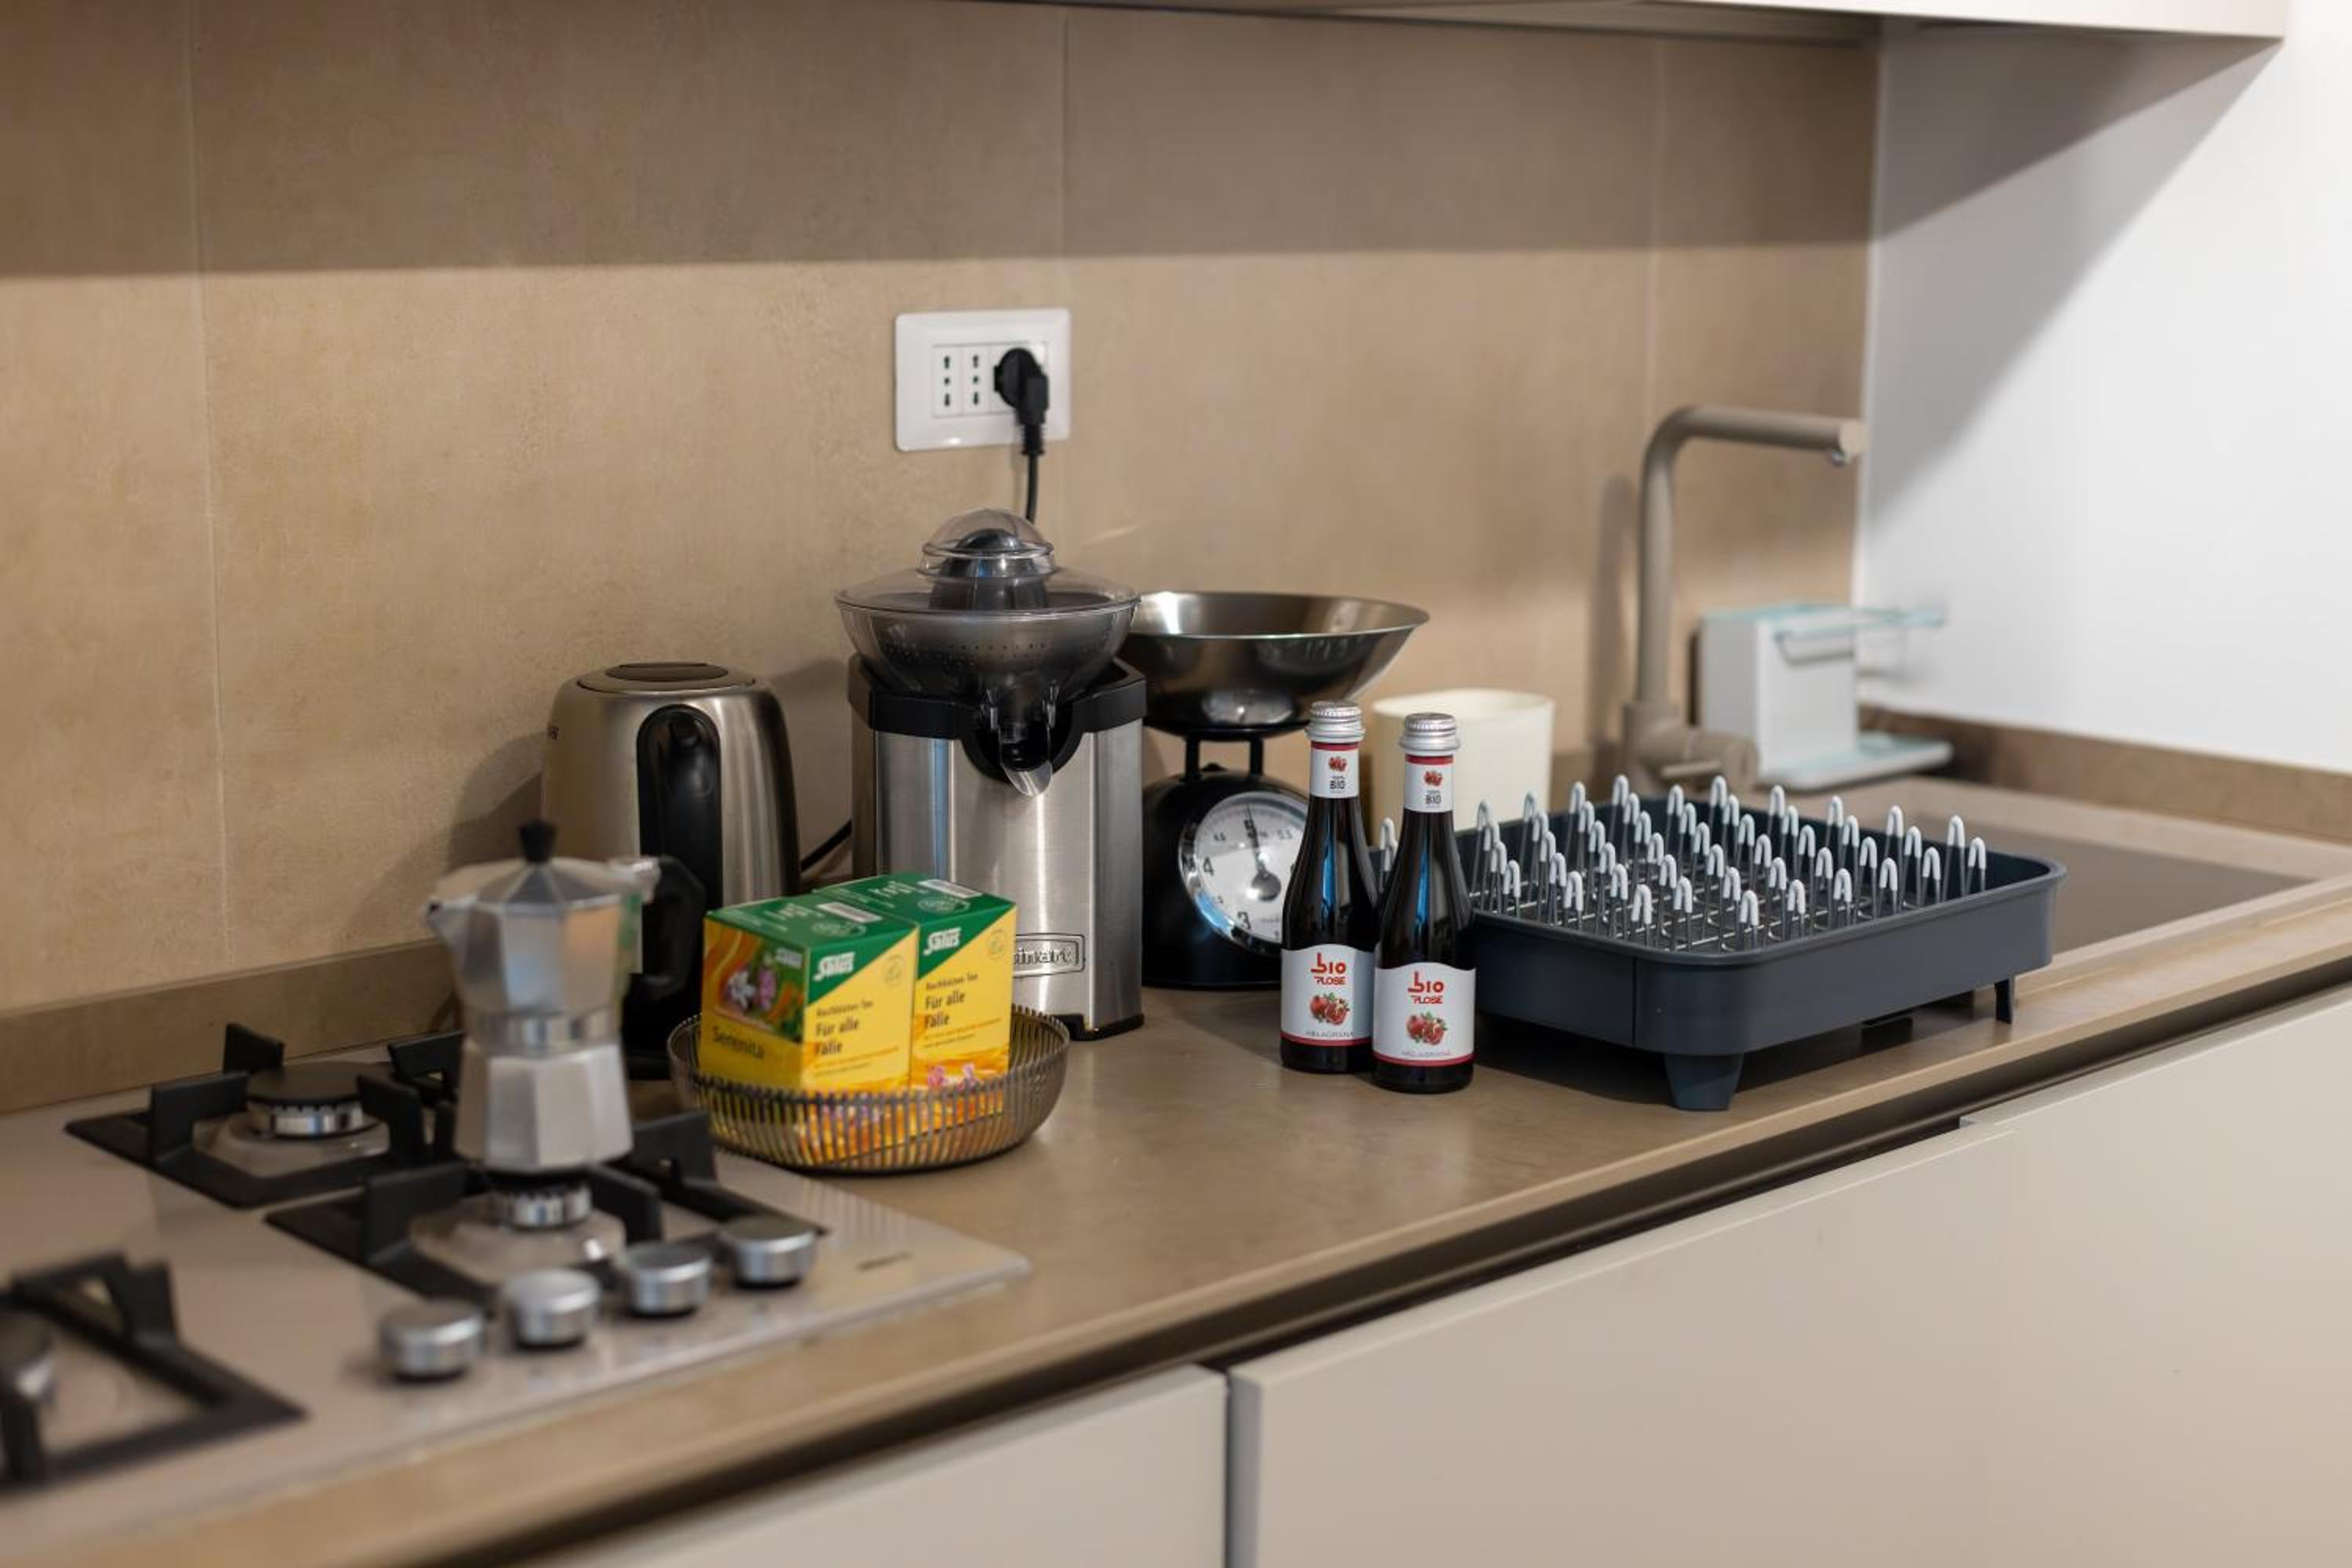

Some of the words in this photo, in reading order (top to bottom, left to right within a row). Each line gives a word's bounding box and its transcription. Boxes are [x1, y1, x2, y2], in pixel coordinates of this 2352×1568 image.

[1330, 780, 1345, 789] BIO
[1425, 795, 1442, 804] BIO
[1203, 857, 1214, 877] 4
[1237, 911, 1251, 931] 3
[1311, 953, 1346, 974] bio
[1408, 971, 1444, 993] bio
[946, 989, 965, 1006] alle
[839, 1017, 859, 1033] alle
